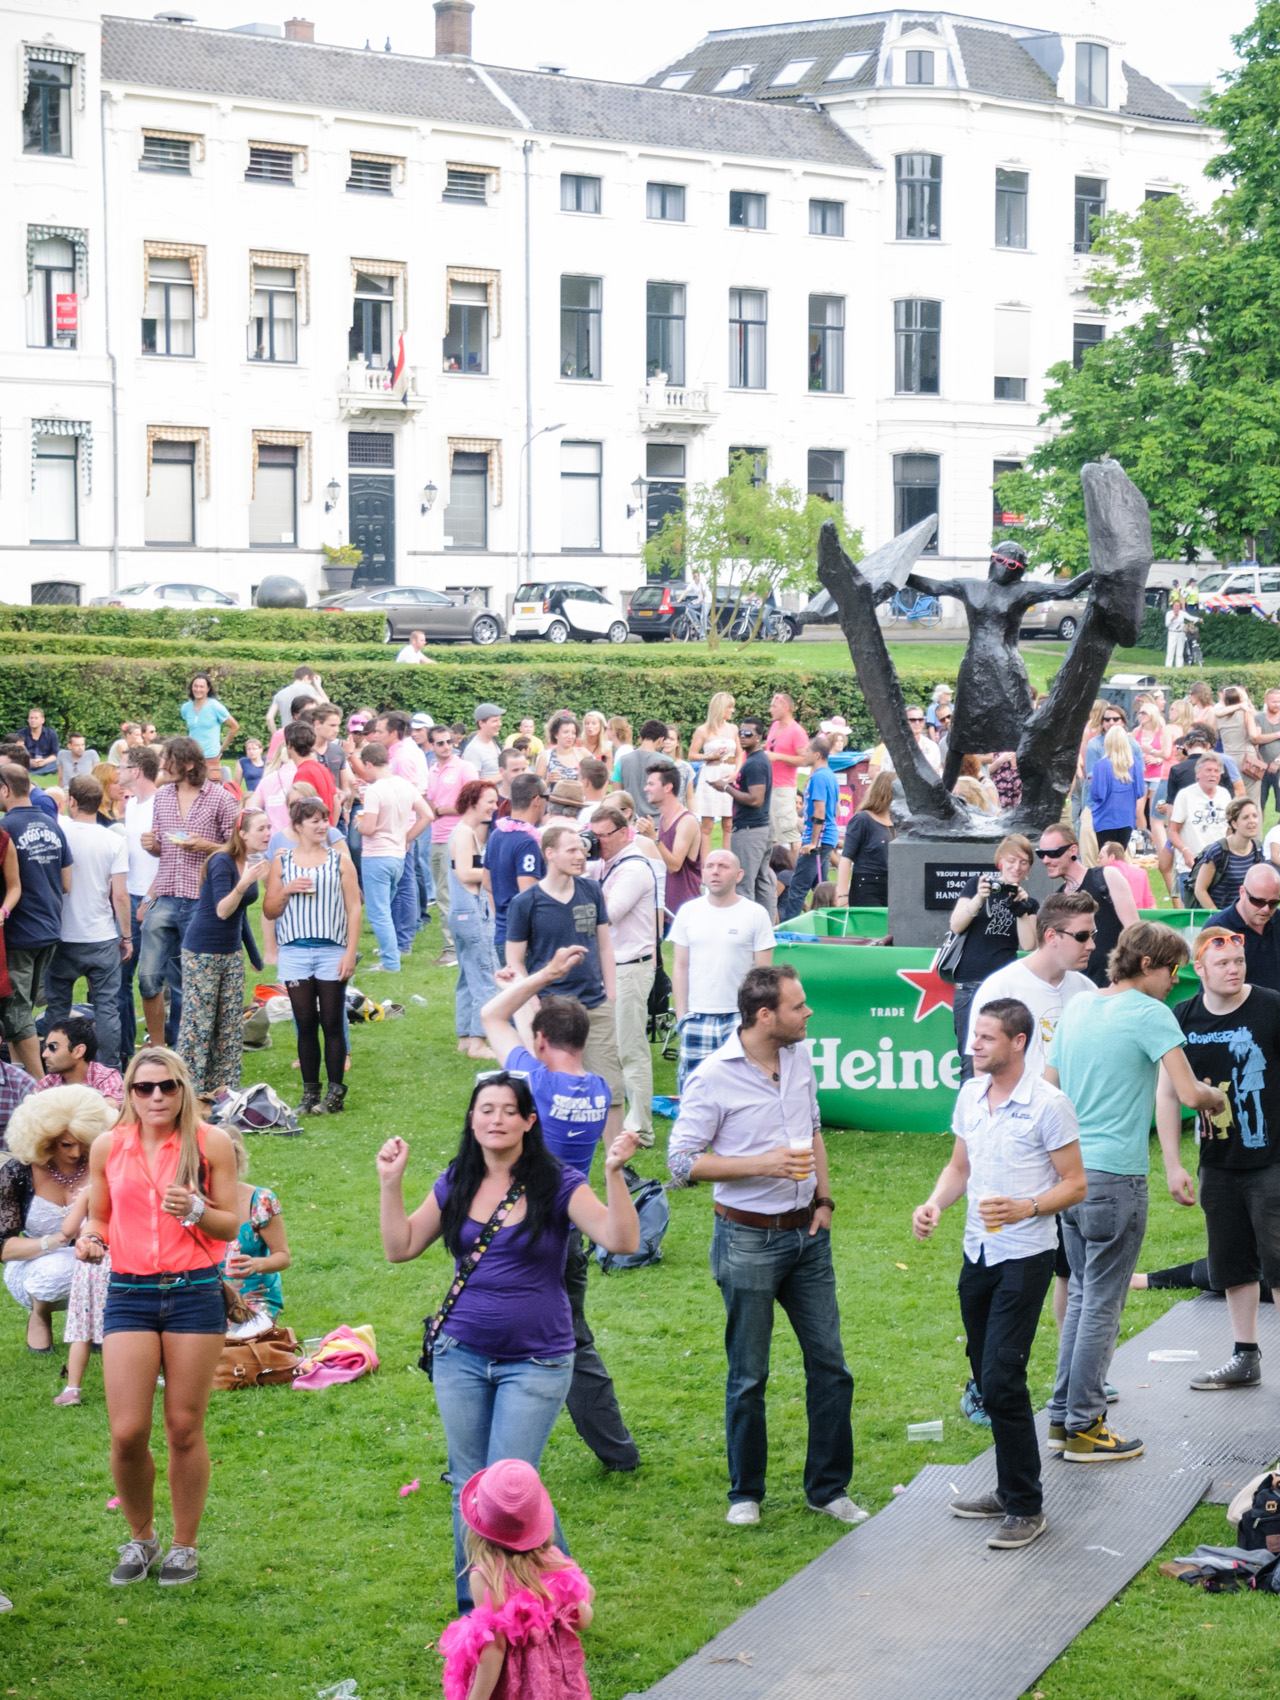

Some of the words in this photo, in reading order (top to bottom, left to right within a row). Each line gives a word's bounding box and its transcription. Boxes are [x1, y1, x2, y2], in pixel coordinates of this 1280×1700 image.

[523, 854, 536, 872] 8
[946, 880, 966, 889] 1940
[935, 891, 961, 899] HANN
[989, 917, 1013, 927] AND
[870, 1007, 905, 1017] TRADE
[804, 1036, 963, 1090] Heine
